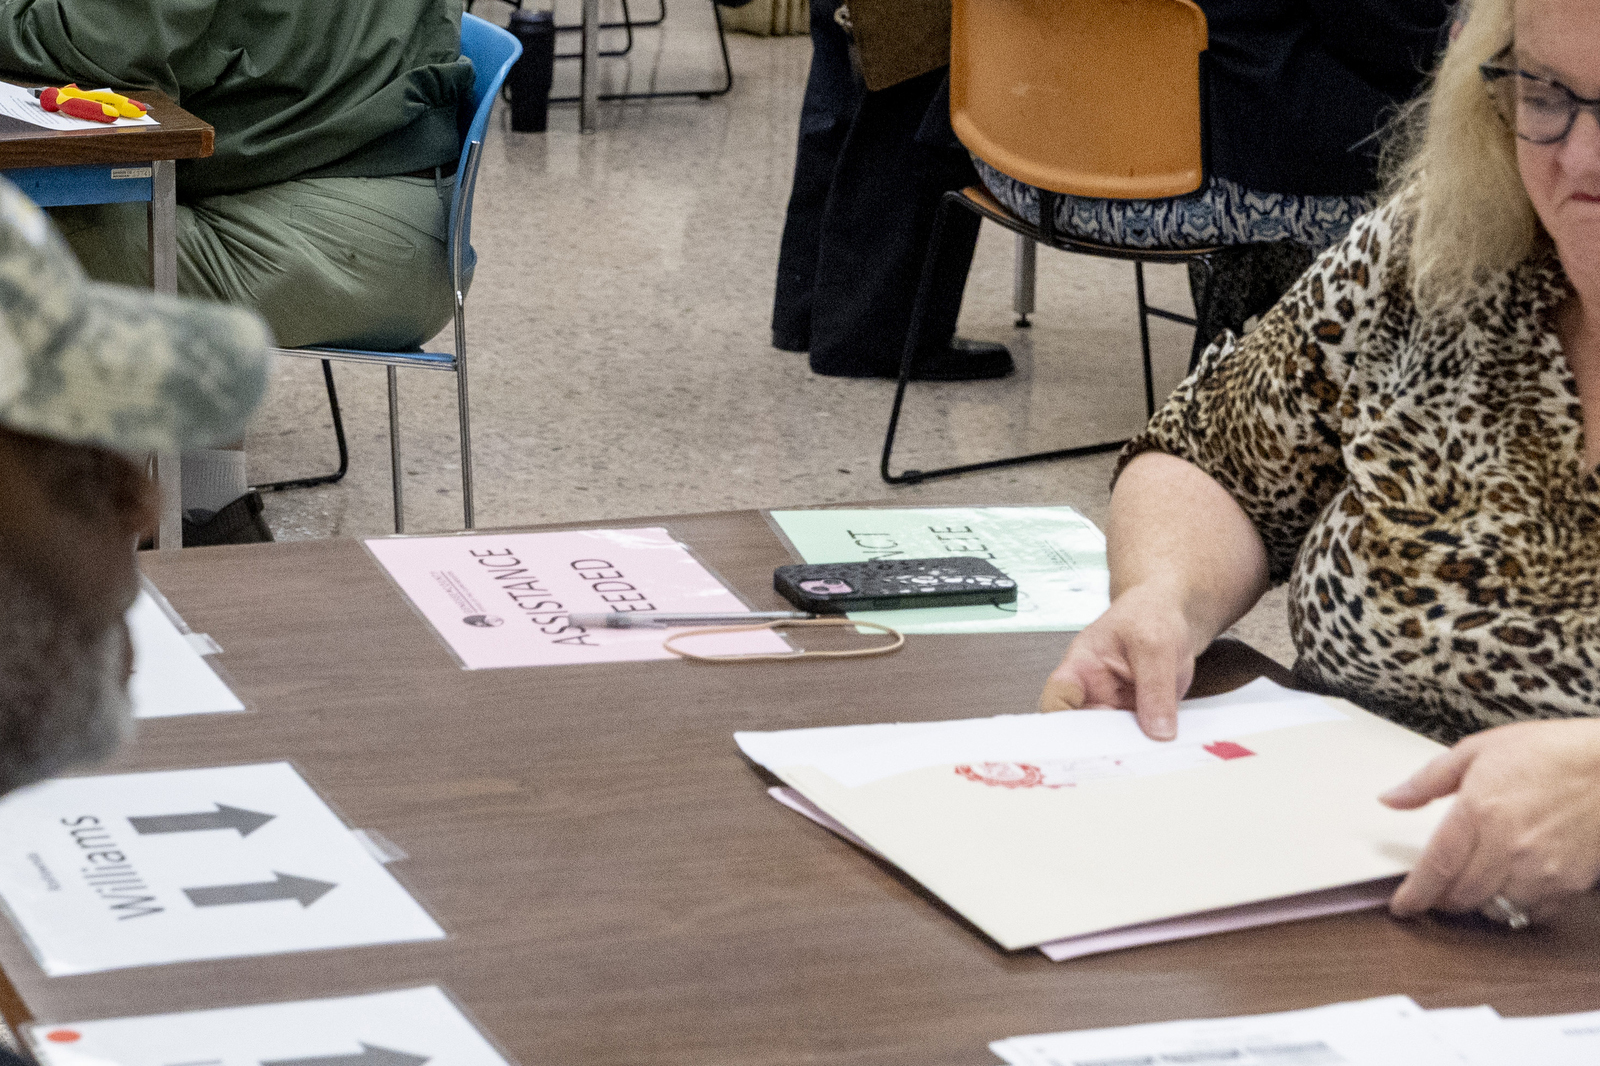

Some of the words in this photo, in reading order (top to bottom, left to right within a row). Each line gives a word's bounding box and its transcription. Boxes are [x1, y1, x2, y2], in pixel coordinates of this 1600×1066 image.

[469, 547, 601, 648] ASSISTANCE
[570, 557, 657, 613] EEDED
[60, 815, 166, 922] Williams
